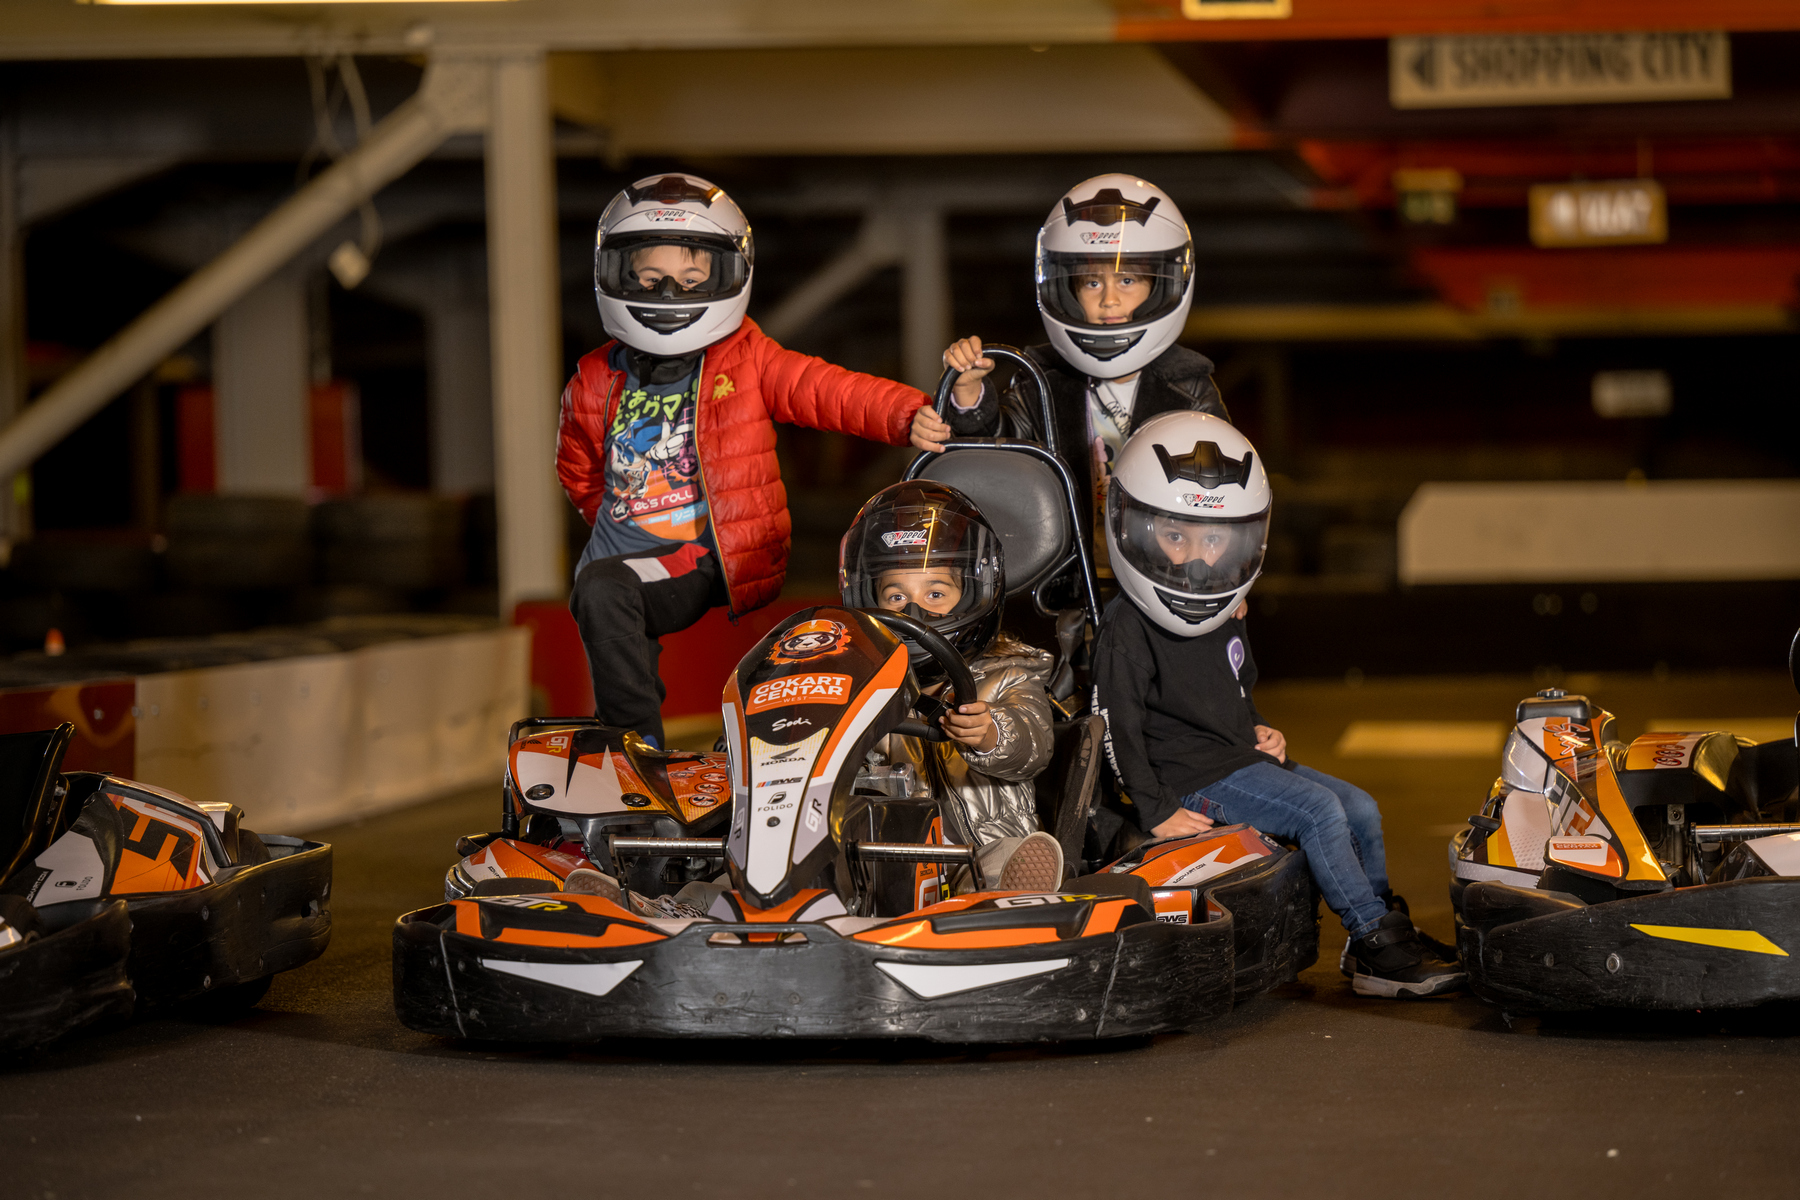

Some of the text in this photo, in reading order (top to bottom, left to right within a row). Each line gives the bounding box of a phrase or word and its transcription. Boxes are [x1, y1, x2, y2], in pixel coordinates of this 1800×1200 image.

[1450, 34, 1714, 87] SHOPPING CITY
[755, 676, 846, 695] GOKART
[753, 685, 844, 704] CENTAR
[783, 695, 808, 703] WEST
[772, 717, 812, 732] Sodi
[760, 757, 806, 767] HONDA
[757, 803, 794, 812] FOLIDO
[805, 798, 823, 833] GTR
[1156, 914, 1188, 924] SWS
